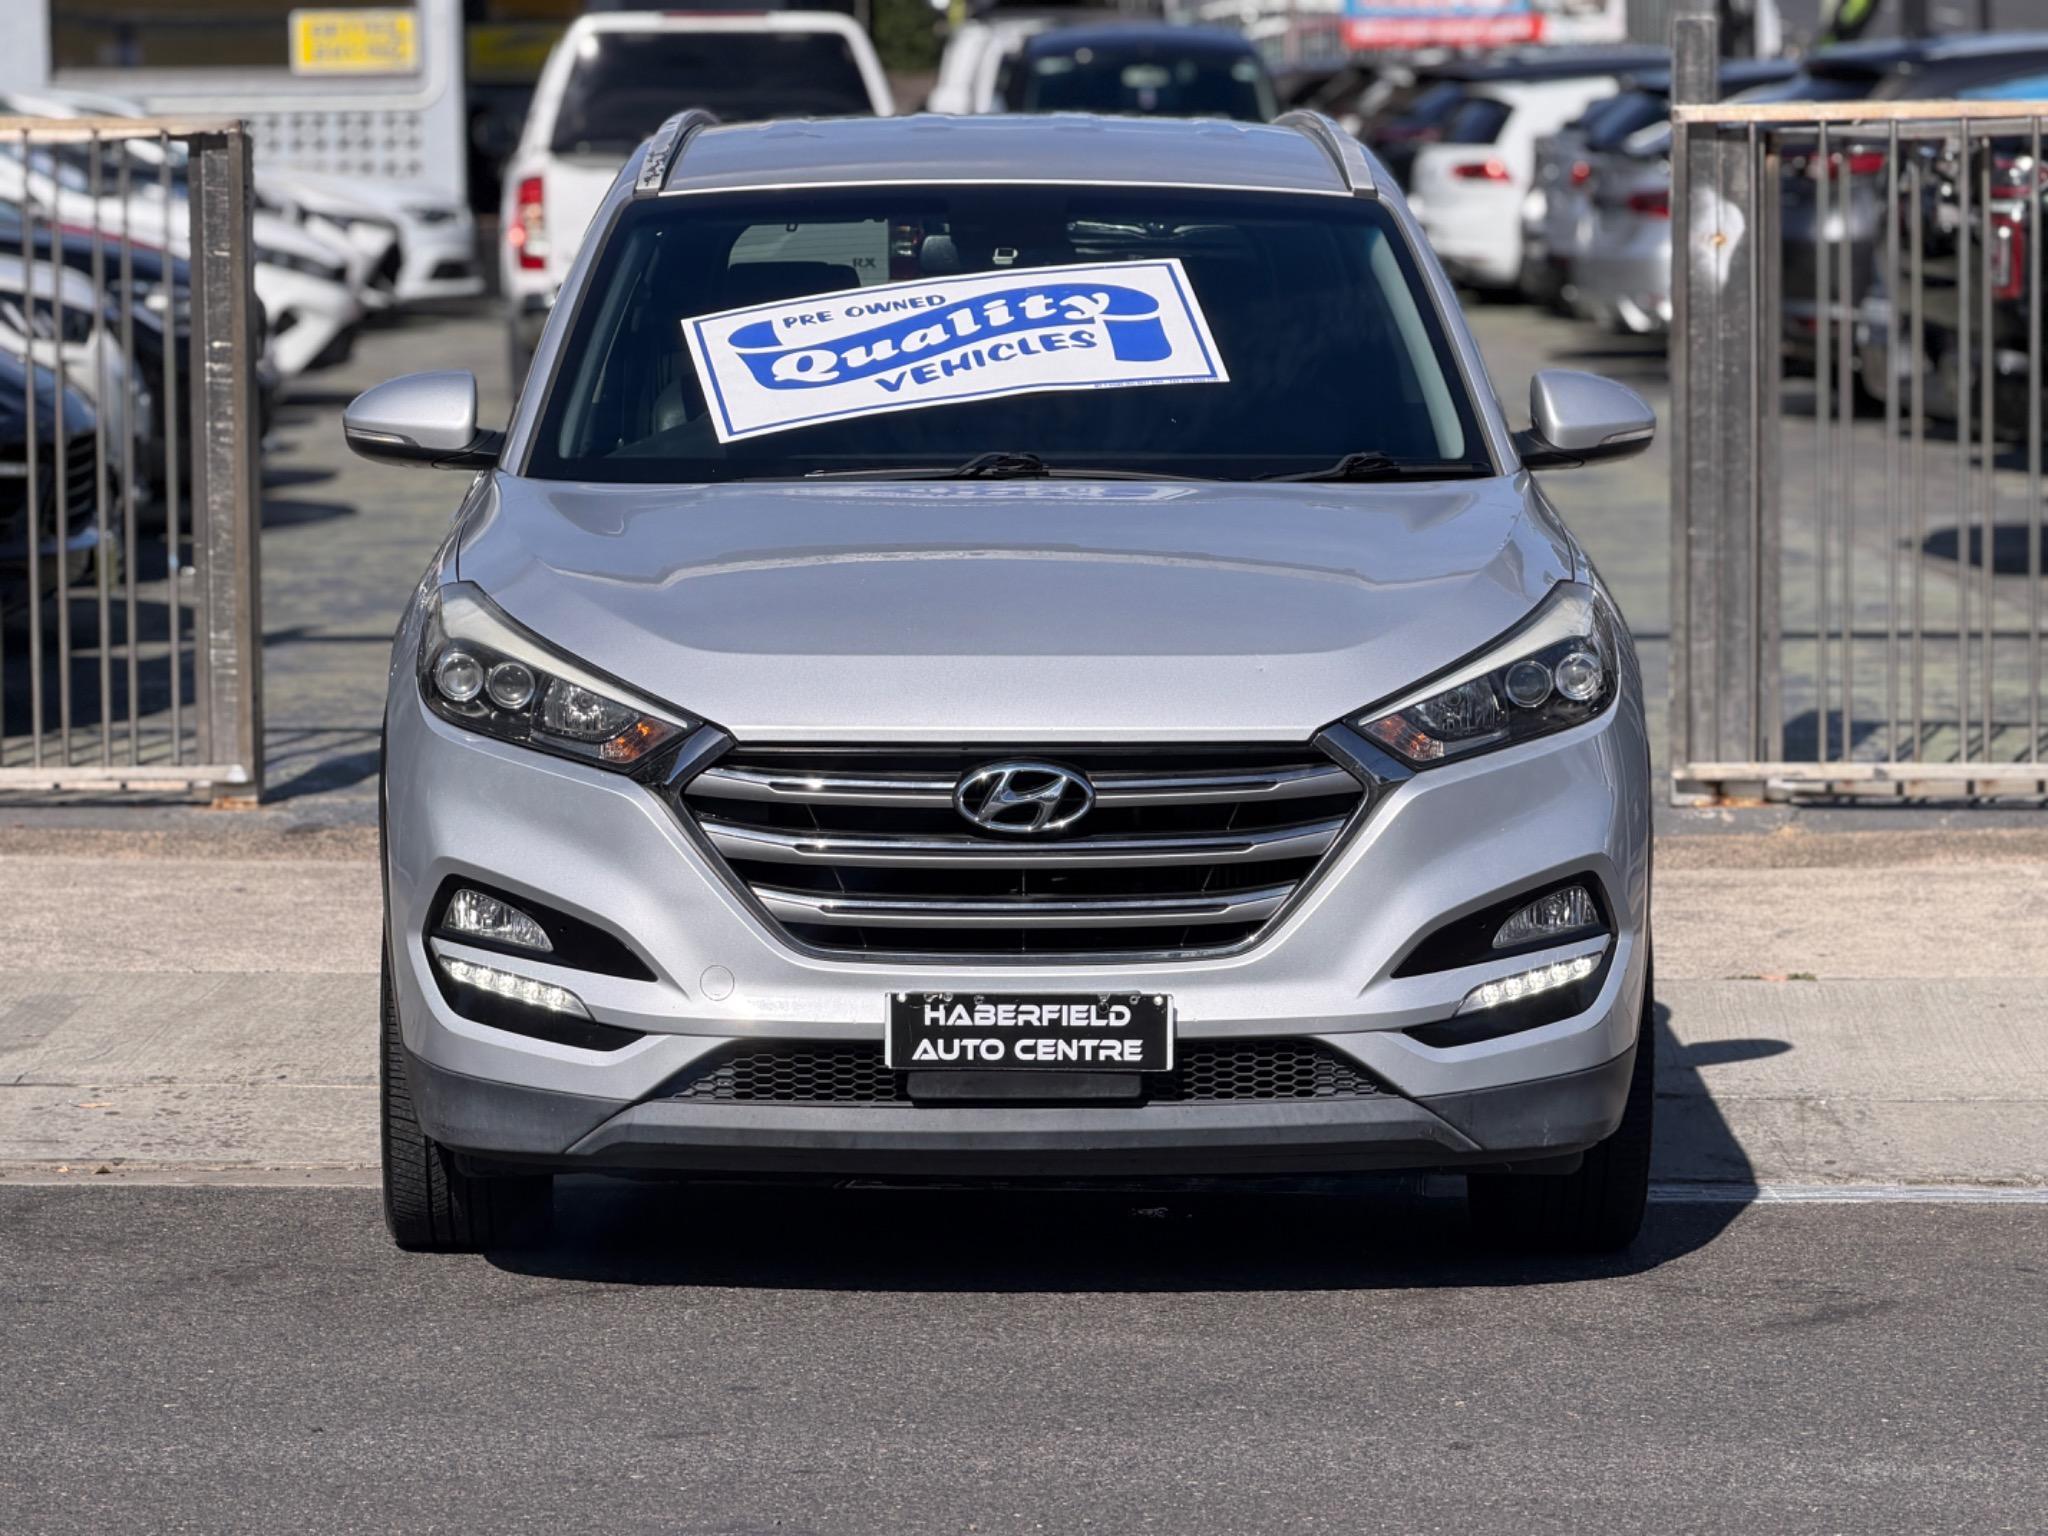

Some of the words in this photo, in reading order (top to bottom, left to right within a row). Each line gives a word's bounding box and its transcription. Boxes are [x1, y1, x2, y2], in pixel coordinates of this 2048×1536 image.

[782, 310, 834, 329] PRE
[844, 294, 946, 318] OWNED
[771, 292, 1110, 382] Quality
[875, 330, 1097, 392] VEHICLES
[924, 1003, 1132, 1026] HABERFIELD
[911, 1038, 1006, 1061] AUTO
[1013, 1038, 1144, 1061] CENTRE
